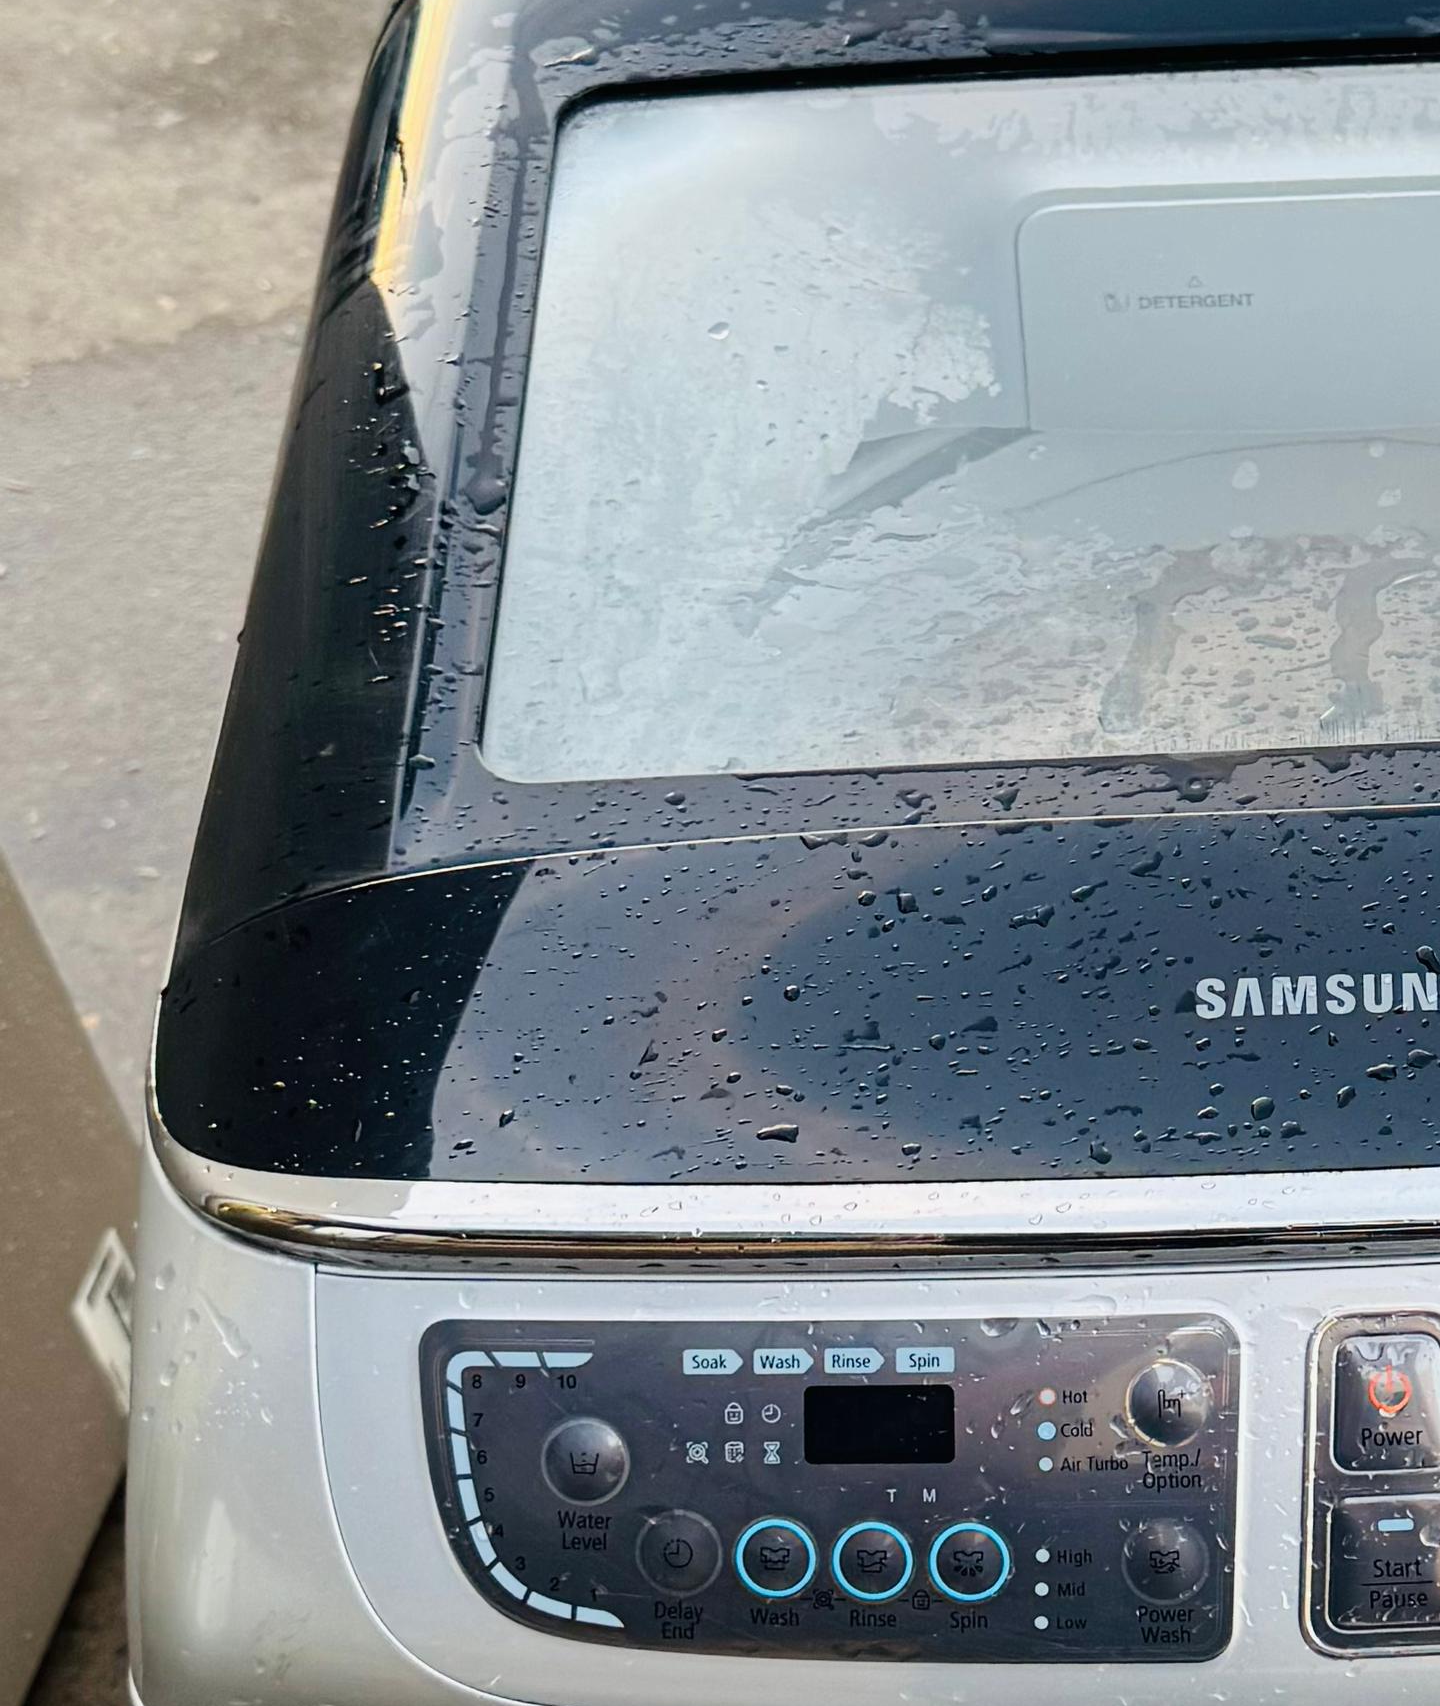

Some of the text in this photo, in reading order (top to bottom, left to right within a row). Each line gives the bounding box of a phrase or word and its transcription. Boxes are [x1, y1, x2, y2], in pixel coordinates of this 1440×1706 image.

[1137, 293, 1255, 310] DETERGENT
[692, 1354, 728, 1370] Soak
[760, 1355, 800, 1370] Wash
[832, 1354, 871, 1369] Rinse
[909, 1353, 941, 1371] Spin
[472, 1373, 483, 1389] 8
[515, 1373, 526, 1389] 9
[557, 1374, 577, 1389] 10
[1062, 1390, 1088, 1404] Hot
[473, 1412, 484, 1427] 7
[1060, 1423, 1094, 1438] Cold
[1361, 1427, 1424, 1447] Power
[477, 1449, 488, 1465] 6
[1060, 1456, 1129, 1472] Air Turbo
[1142, 1470, 1202, 1493] Option
[484, 1487, 495, 1503] 5
[558, 1510, 613, 1530] Water
[494, 1523, 504, 1538] 4
[562, 1533, 608, 1550] Level
[515, 1555, 526, 1571] 3
[1057, 1549, 1093, 1567] High
[1373, 1558, 1423, 1578] Start
[550, 1577, 560, 1592] 2
[1057, 1582, 1086, 1597] Mid
[1369, 1590, 1429, 1610] Pause
[654, 1601, 704, 1624] Delay
[751, 1608, 800, 1626] Wash
[850, 1609, 897, 1627] Rinse
[950, 1610, 988, 1630] Spin
[1137, 1605, 1195, 1624] Power
[1057, 1617, 1087, 1630] Low
[662, 1624, 695, 1640] End
[1141, 1626, 1191, 1644] Wash
